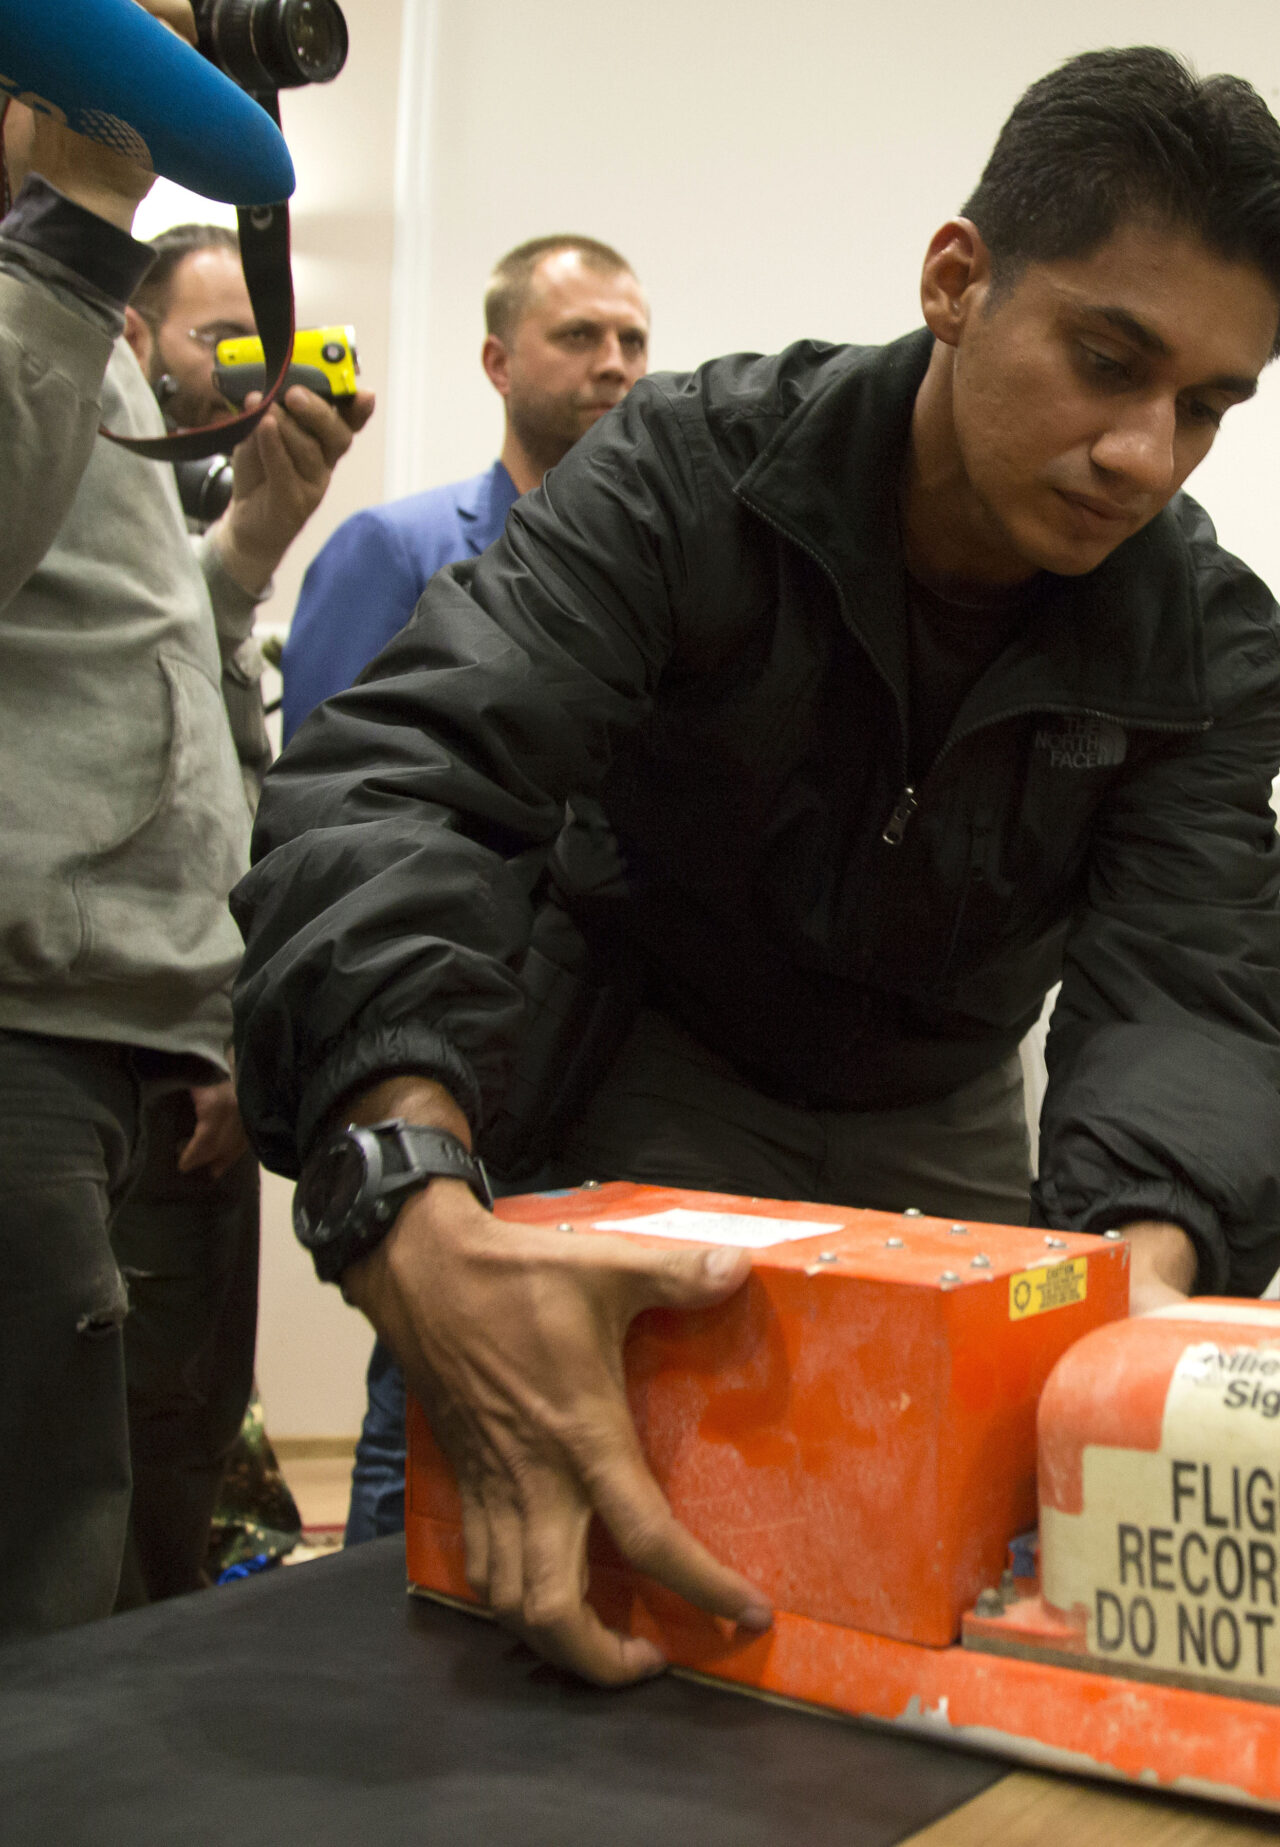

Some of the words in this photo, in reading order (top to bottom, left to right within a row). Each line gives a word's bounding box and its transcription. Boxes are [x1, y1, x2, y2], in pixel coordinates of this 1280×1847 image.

[1050, 751, 1097, 769] FACE
[1095, 1588, 1158, 1658] DO
[1177, 1602, 1275, 1677] NOT
